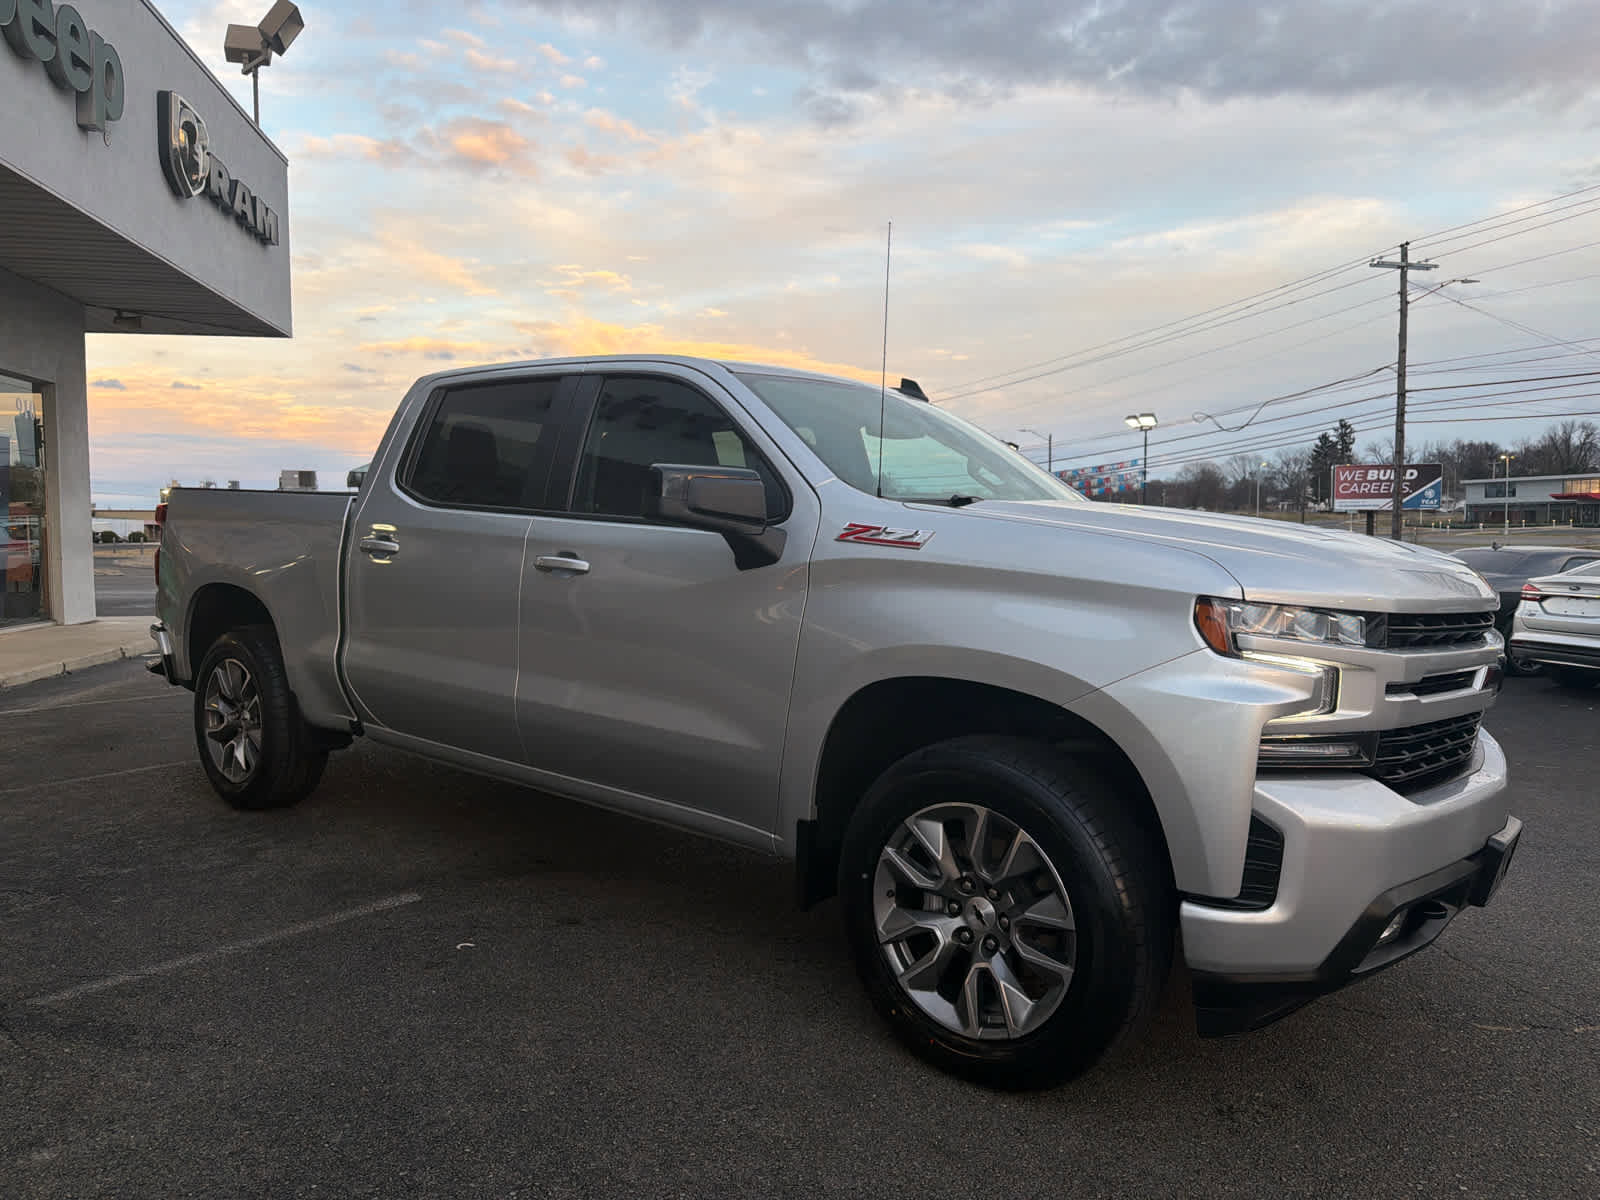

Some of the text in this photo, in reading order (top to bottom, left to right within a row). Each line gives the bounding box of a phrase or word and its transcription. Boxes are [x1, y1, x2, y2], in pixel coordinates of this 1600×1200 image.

[0, 0, 125, 132] eep
[205, 151, 280, 246] RAM
[1340, 468, 1419, 481] WE BUID
[834, 521, 936, 550] Z71
